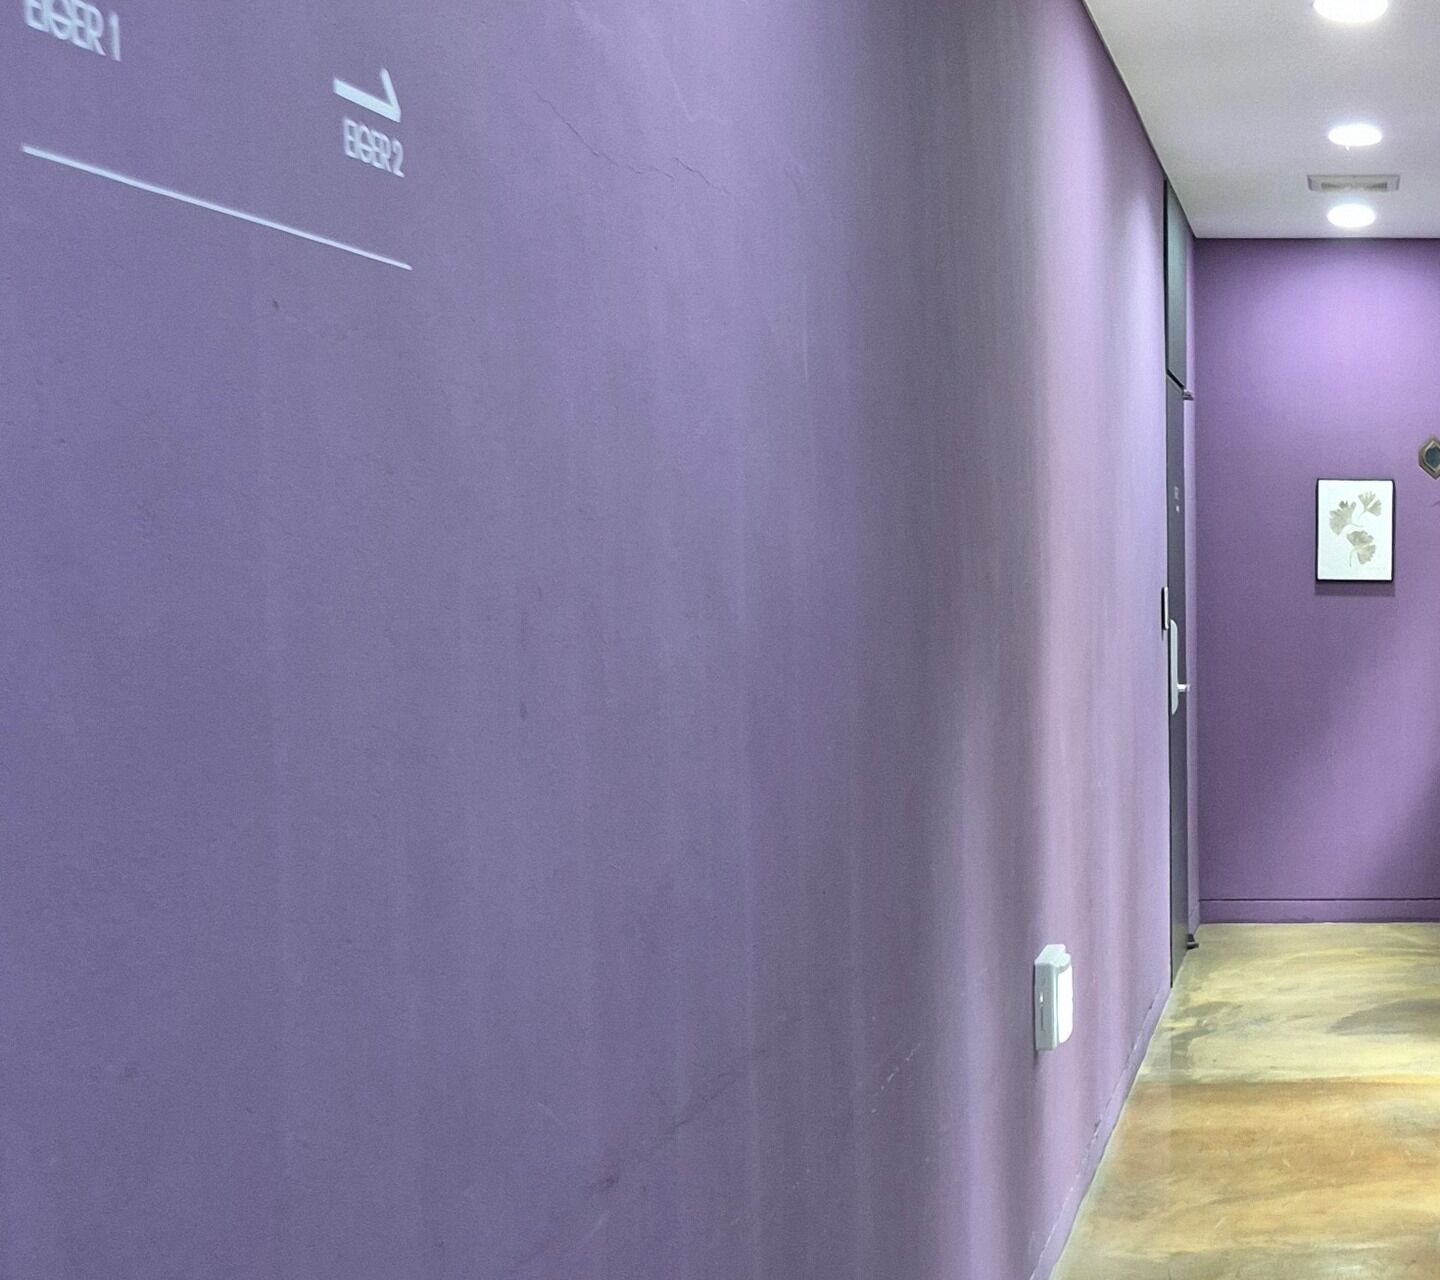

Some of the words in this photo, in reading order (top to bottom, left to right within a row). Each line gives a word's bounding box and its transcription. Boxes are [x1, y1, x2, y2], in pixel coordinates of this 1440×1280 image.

[109, 10, 121, 62] 1
[343, 117, 392, 173] EIGER
[391, 137, 405, 178] 2
